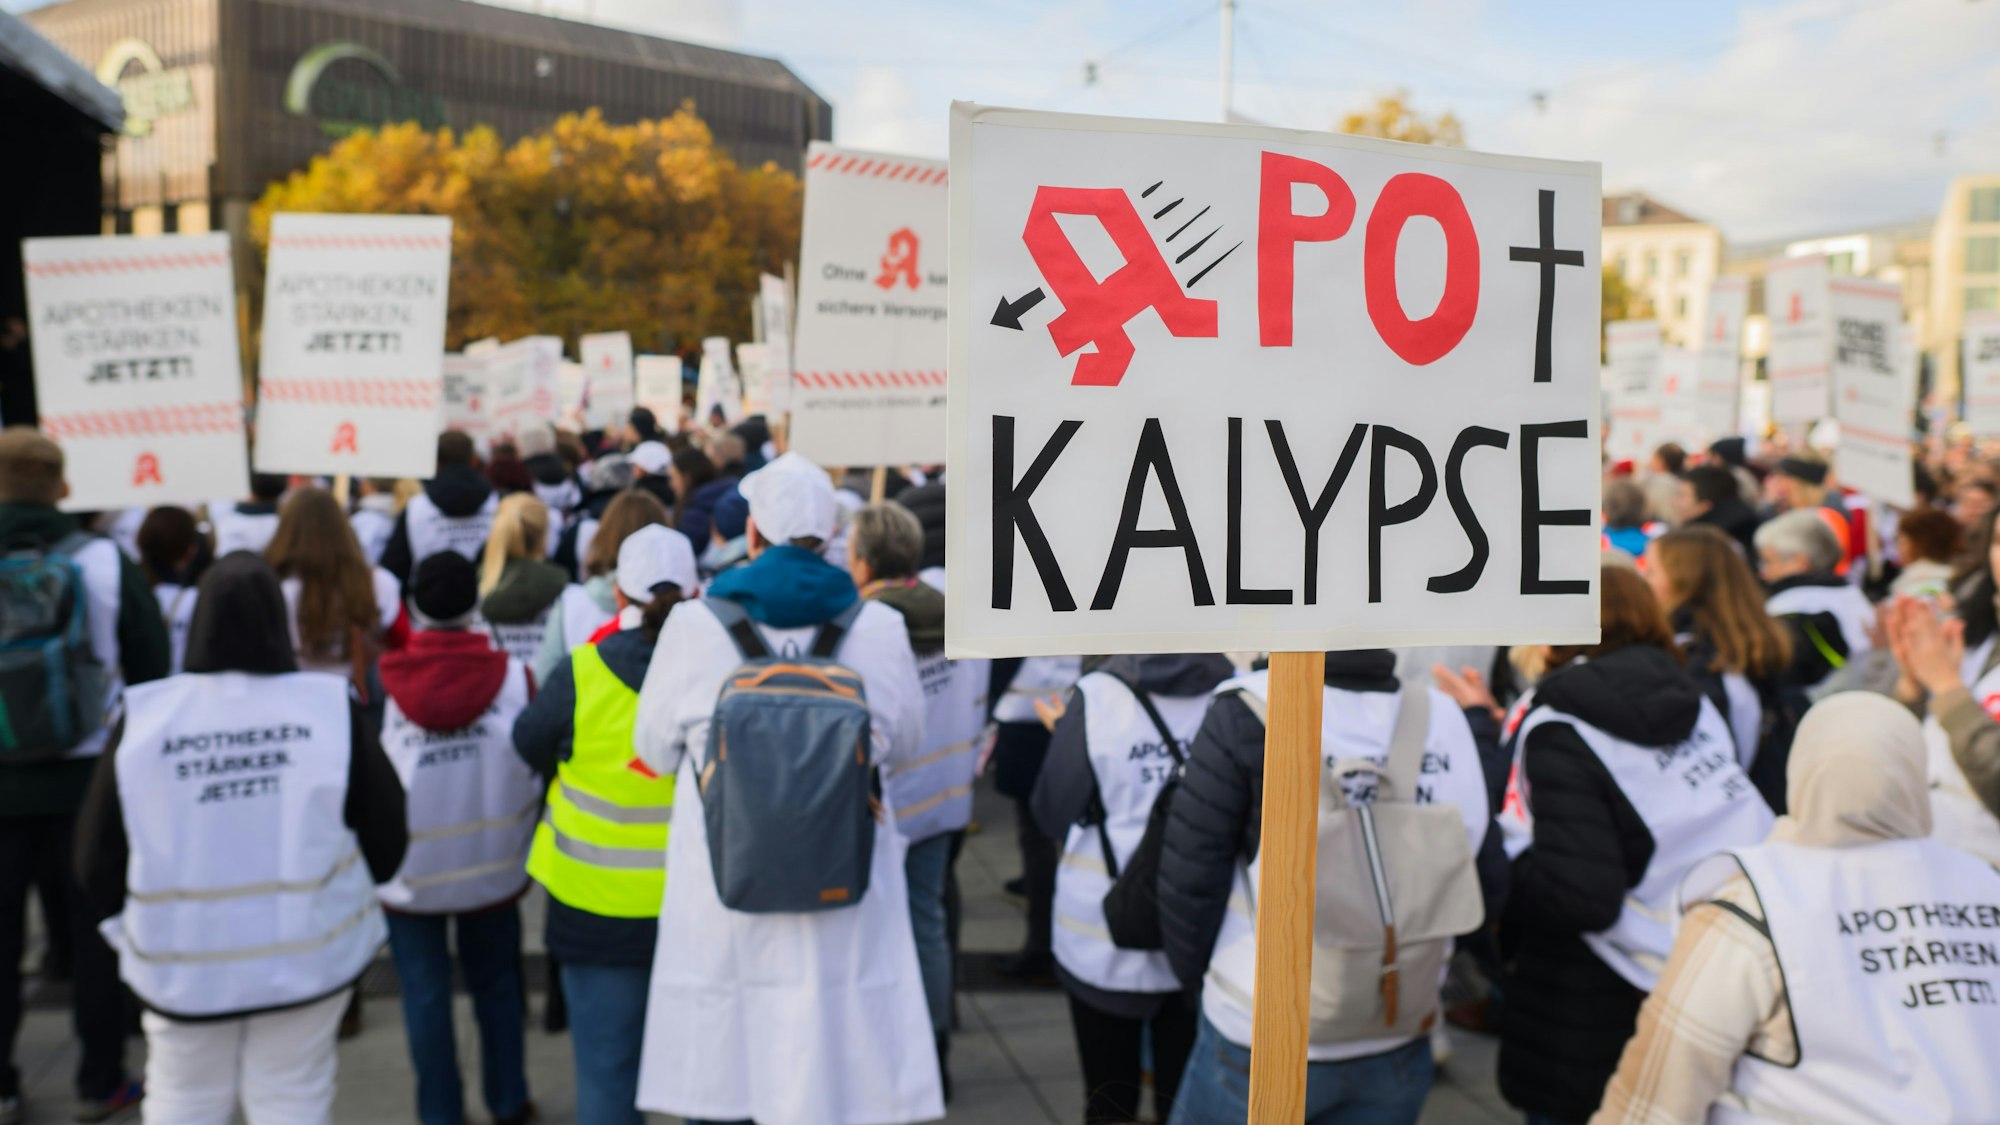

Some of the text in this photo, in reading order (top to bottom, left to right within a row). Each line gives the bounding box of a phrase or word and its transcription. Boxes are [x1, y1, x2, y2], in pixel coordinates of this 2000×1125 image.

[822, 263, 867, 281] Ohne
[304, 329, 402, 354] JETZT!
[85, 354, 195, 385] JETZT!
[991, 414, 1591, 612] KALYPSE
[162, 723, 312, 757] APOTHEKEN
[198, 774, 280, 805] JETZT!
